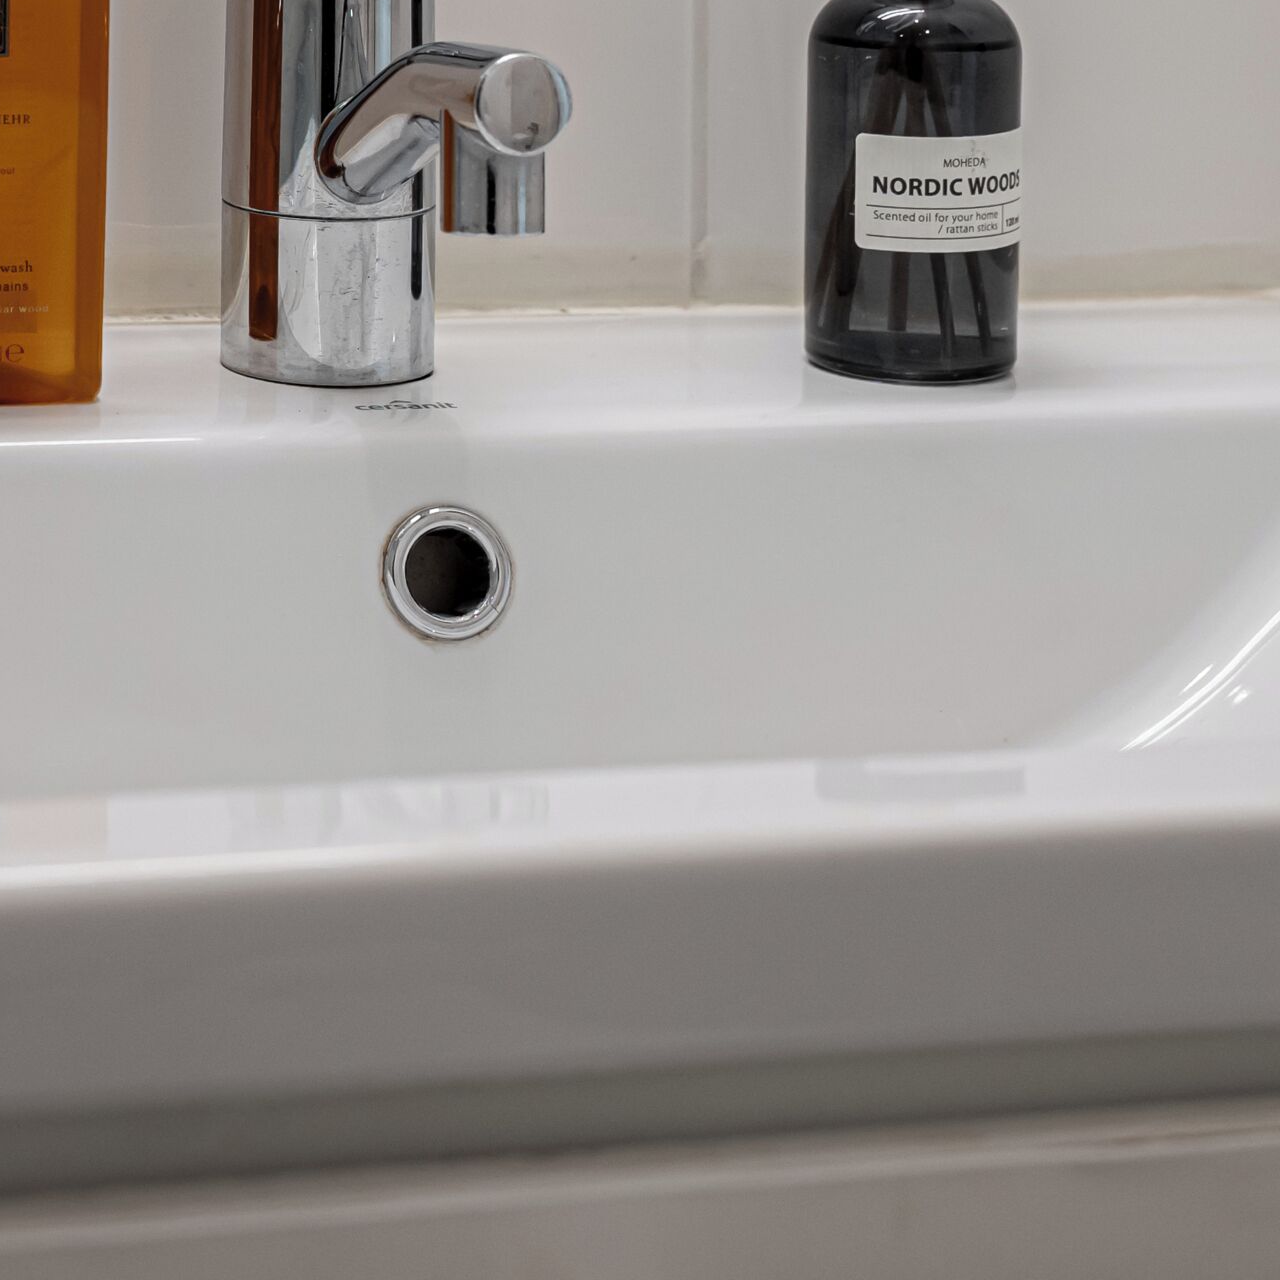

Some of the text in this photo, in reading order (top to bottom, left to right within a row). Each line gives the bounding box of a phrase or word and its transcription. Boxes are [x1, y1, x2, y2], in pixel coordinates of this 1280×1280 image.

[943, 157, 986, 168] MOHEDA
[872, 168, 1020, 197] NORDIC WOODS
[872, 209, 999, 224] Scented oil for your home
[946, 224, 975, 234] rattan
[977, 221, 998, 232] sticks
[0, 260, 33, 273] wash
[354, 400, 458, 411] cersanit
